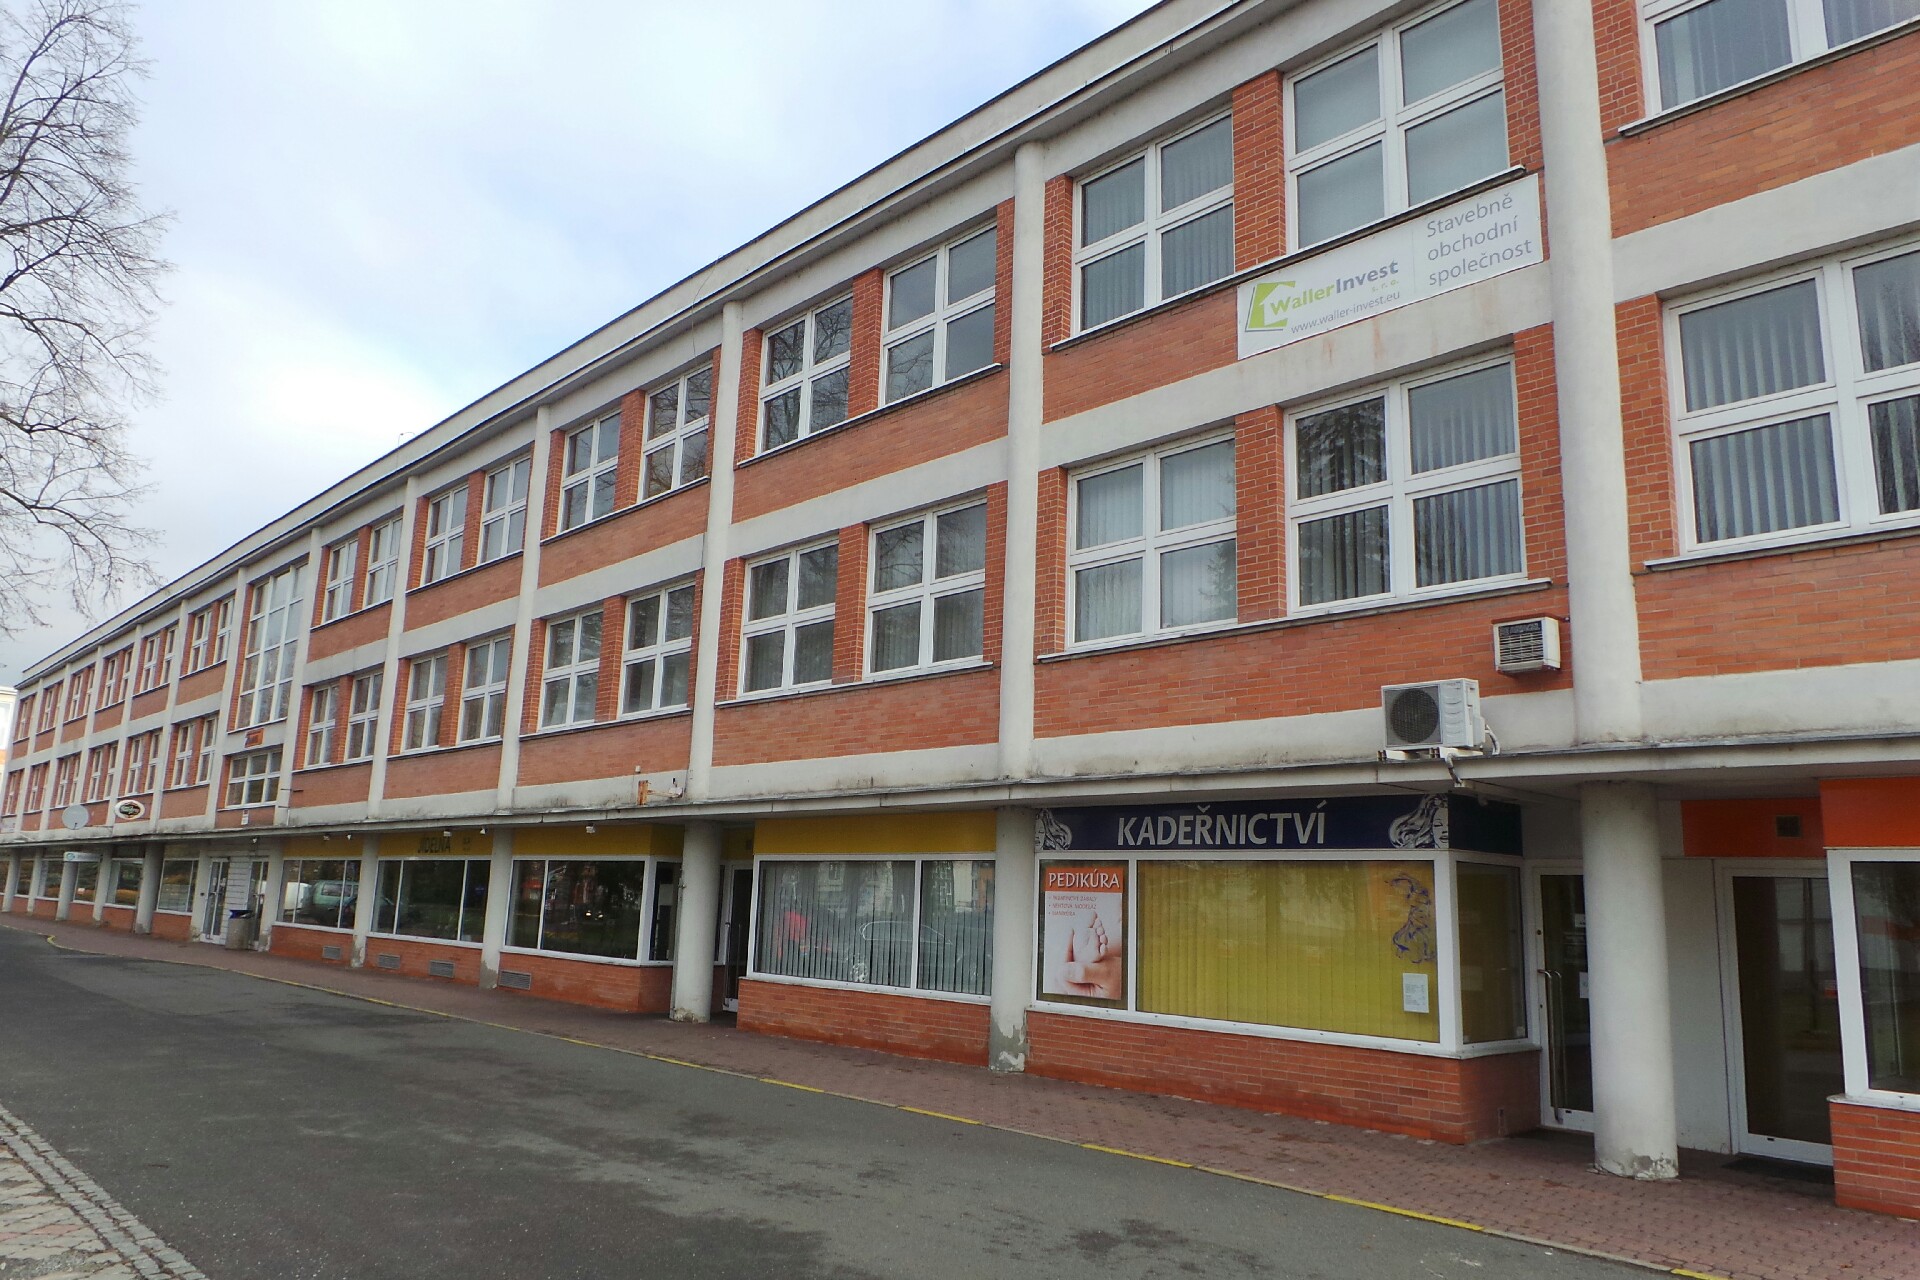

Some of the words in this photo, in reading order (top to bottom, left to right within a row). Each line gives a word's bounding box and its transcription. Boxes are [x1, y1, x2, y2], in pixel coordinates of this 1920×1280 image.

[1427, 194, 1513, 237] Stavebně
[1428, 216, 1518, 260] obchodní
[1429, 239, 1532, 286] společnost
[1290, 292, 1400, 334] www.waller-invest.eu
[1117, 801, 1327, 846] KADEŘNICTVÍ
[1049, 869, 1120, 889] PEDIKÚRA
